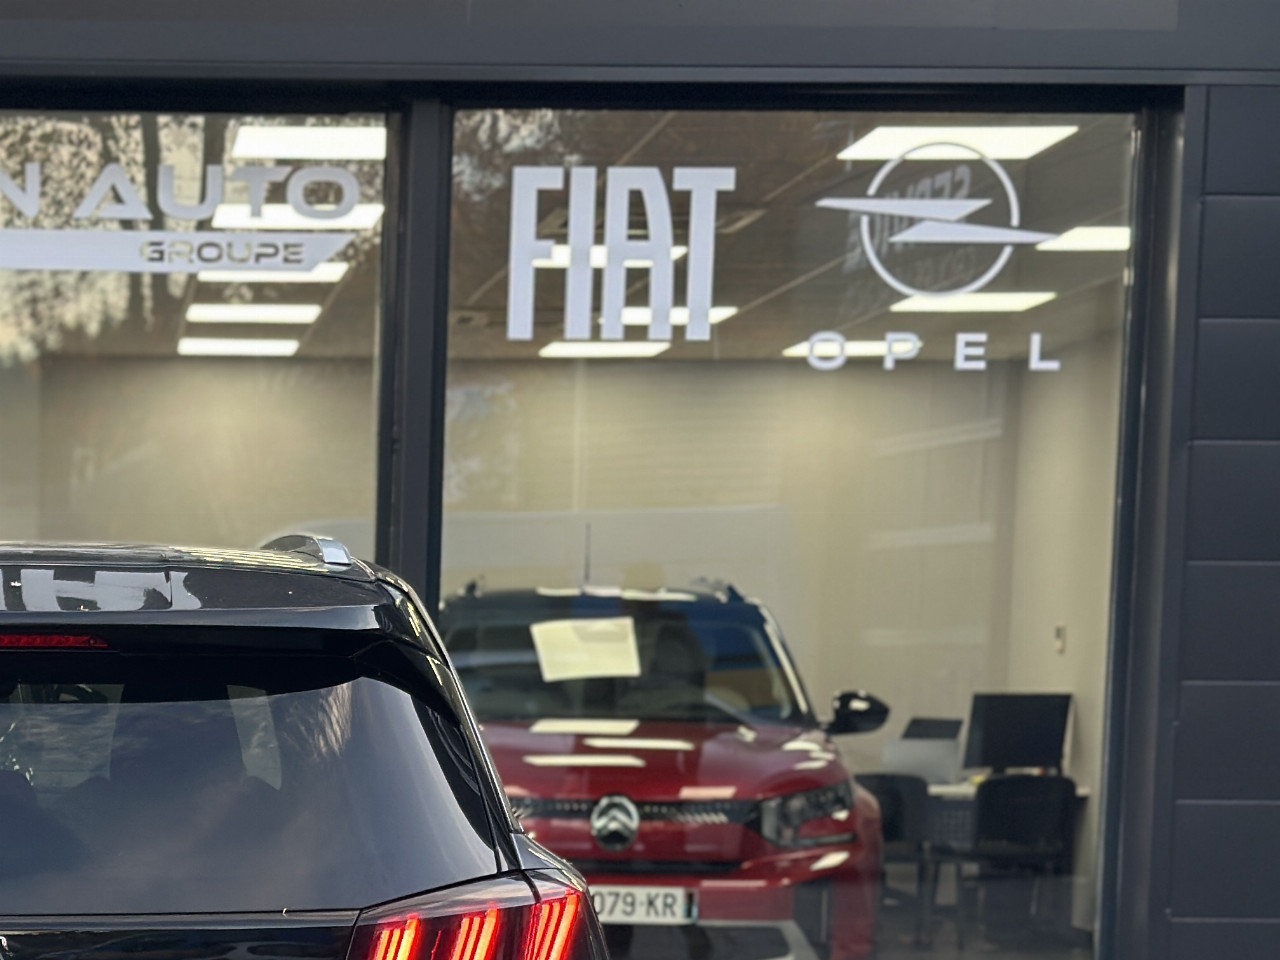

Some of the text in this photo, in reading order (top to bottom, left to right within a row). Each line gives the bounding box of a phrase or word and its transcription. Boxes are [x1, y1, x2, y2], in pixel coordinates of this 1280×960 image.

[73, 162, 361, 221] AUTO
[142, 240, 304, 264] GROUPE
[506, 165, 737, 342] FIAT
[806, 330, 1062, 371] OPEL
